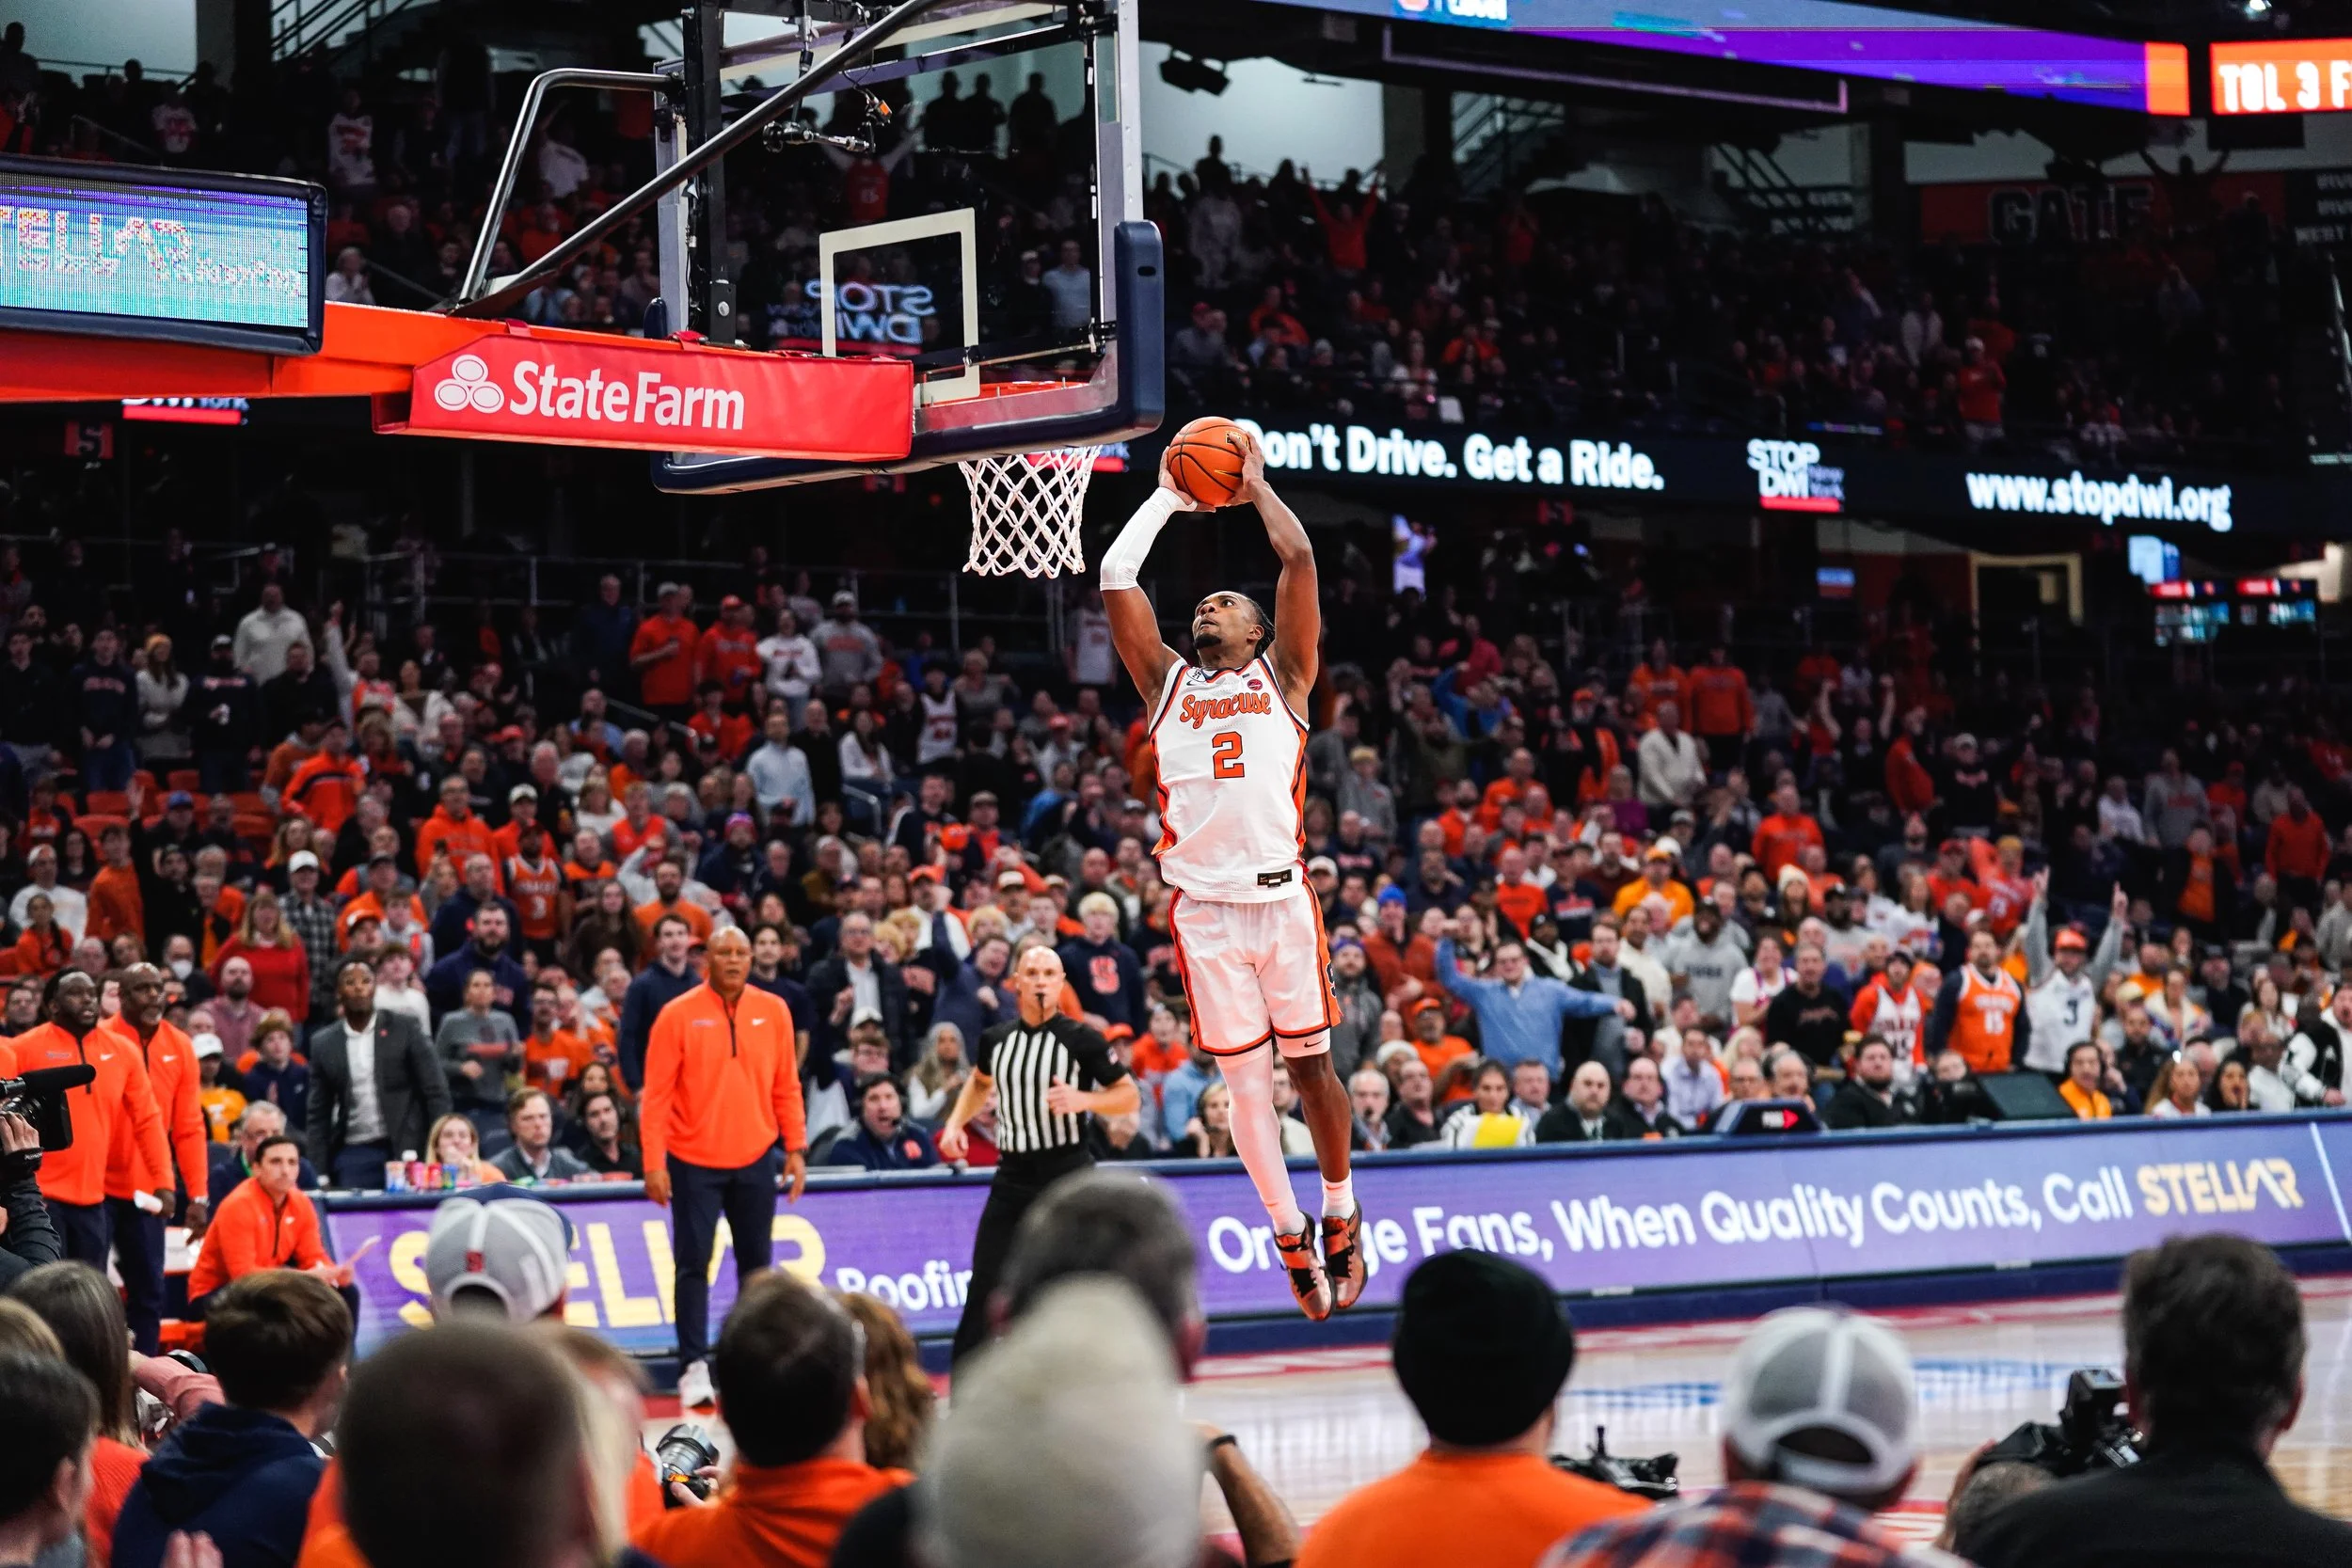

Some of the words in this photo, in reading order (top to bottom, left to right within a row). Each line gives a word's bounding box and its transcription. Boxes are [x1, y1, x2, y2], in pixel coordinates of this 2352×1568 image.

[2218, 63, 2287, 112] TOL
[2296, 61, 2320, 109] 3
[1346, 425, 1457, 477] Drive.
[1464, 433, 1533, 483] Get
[1537, 447, 1563, 484] a
[1570, 438, 1664, 490] Ride.
[1747, 438, 1820, 471] STOP
[1758, 467, 1809, 499] DWI
[1180, 692, 1272, 729] Syracuse
[1212, 731, 1245, 780] 2
[1208, 1215, 1408, 1276] Orge
[1412, 1206, 1553, 1262] Fans,
[1550, 1195, 1696, 1252] When
[1701, 1182, 1865, 1248] Quality
[1871, 1181, 2042, 1232] Counts,
[2042, 1165, 2133, 1223] Call
[2137, 1157, 2304, 1217] STELLAR
[835, 1259, 973, 1311] Roofin
